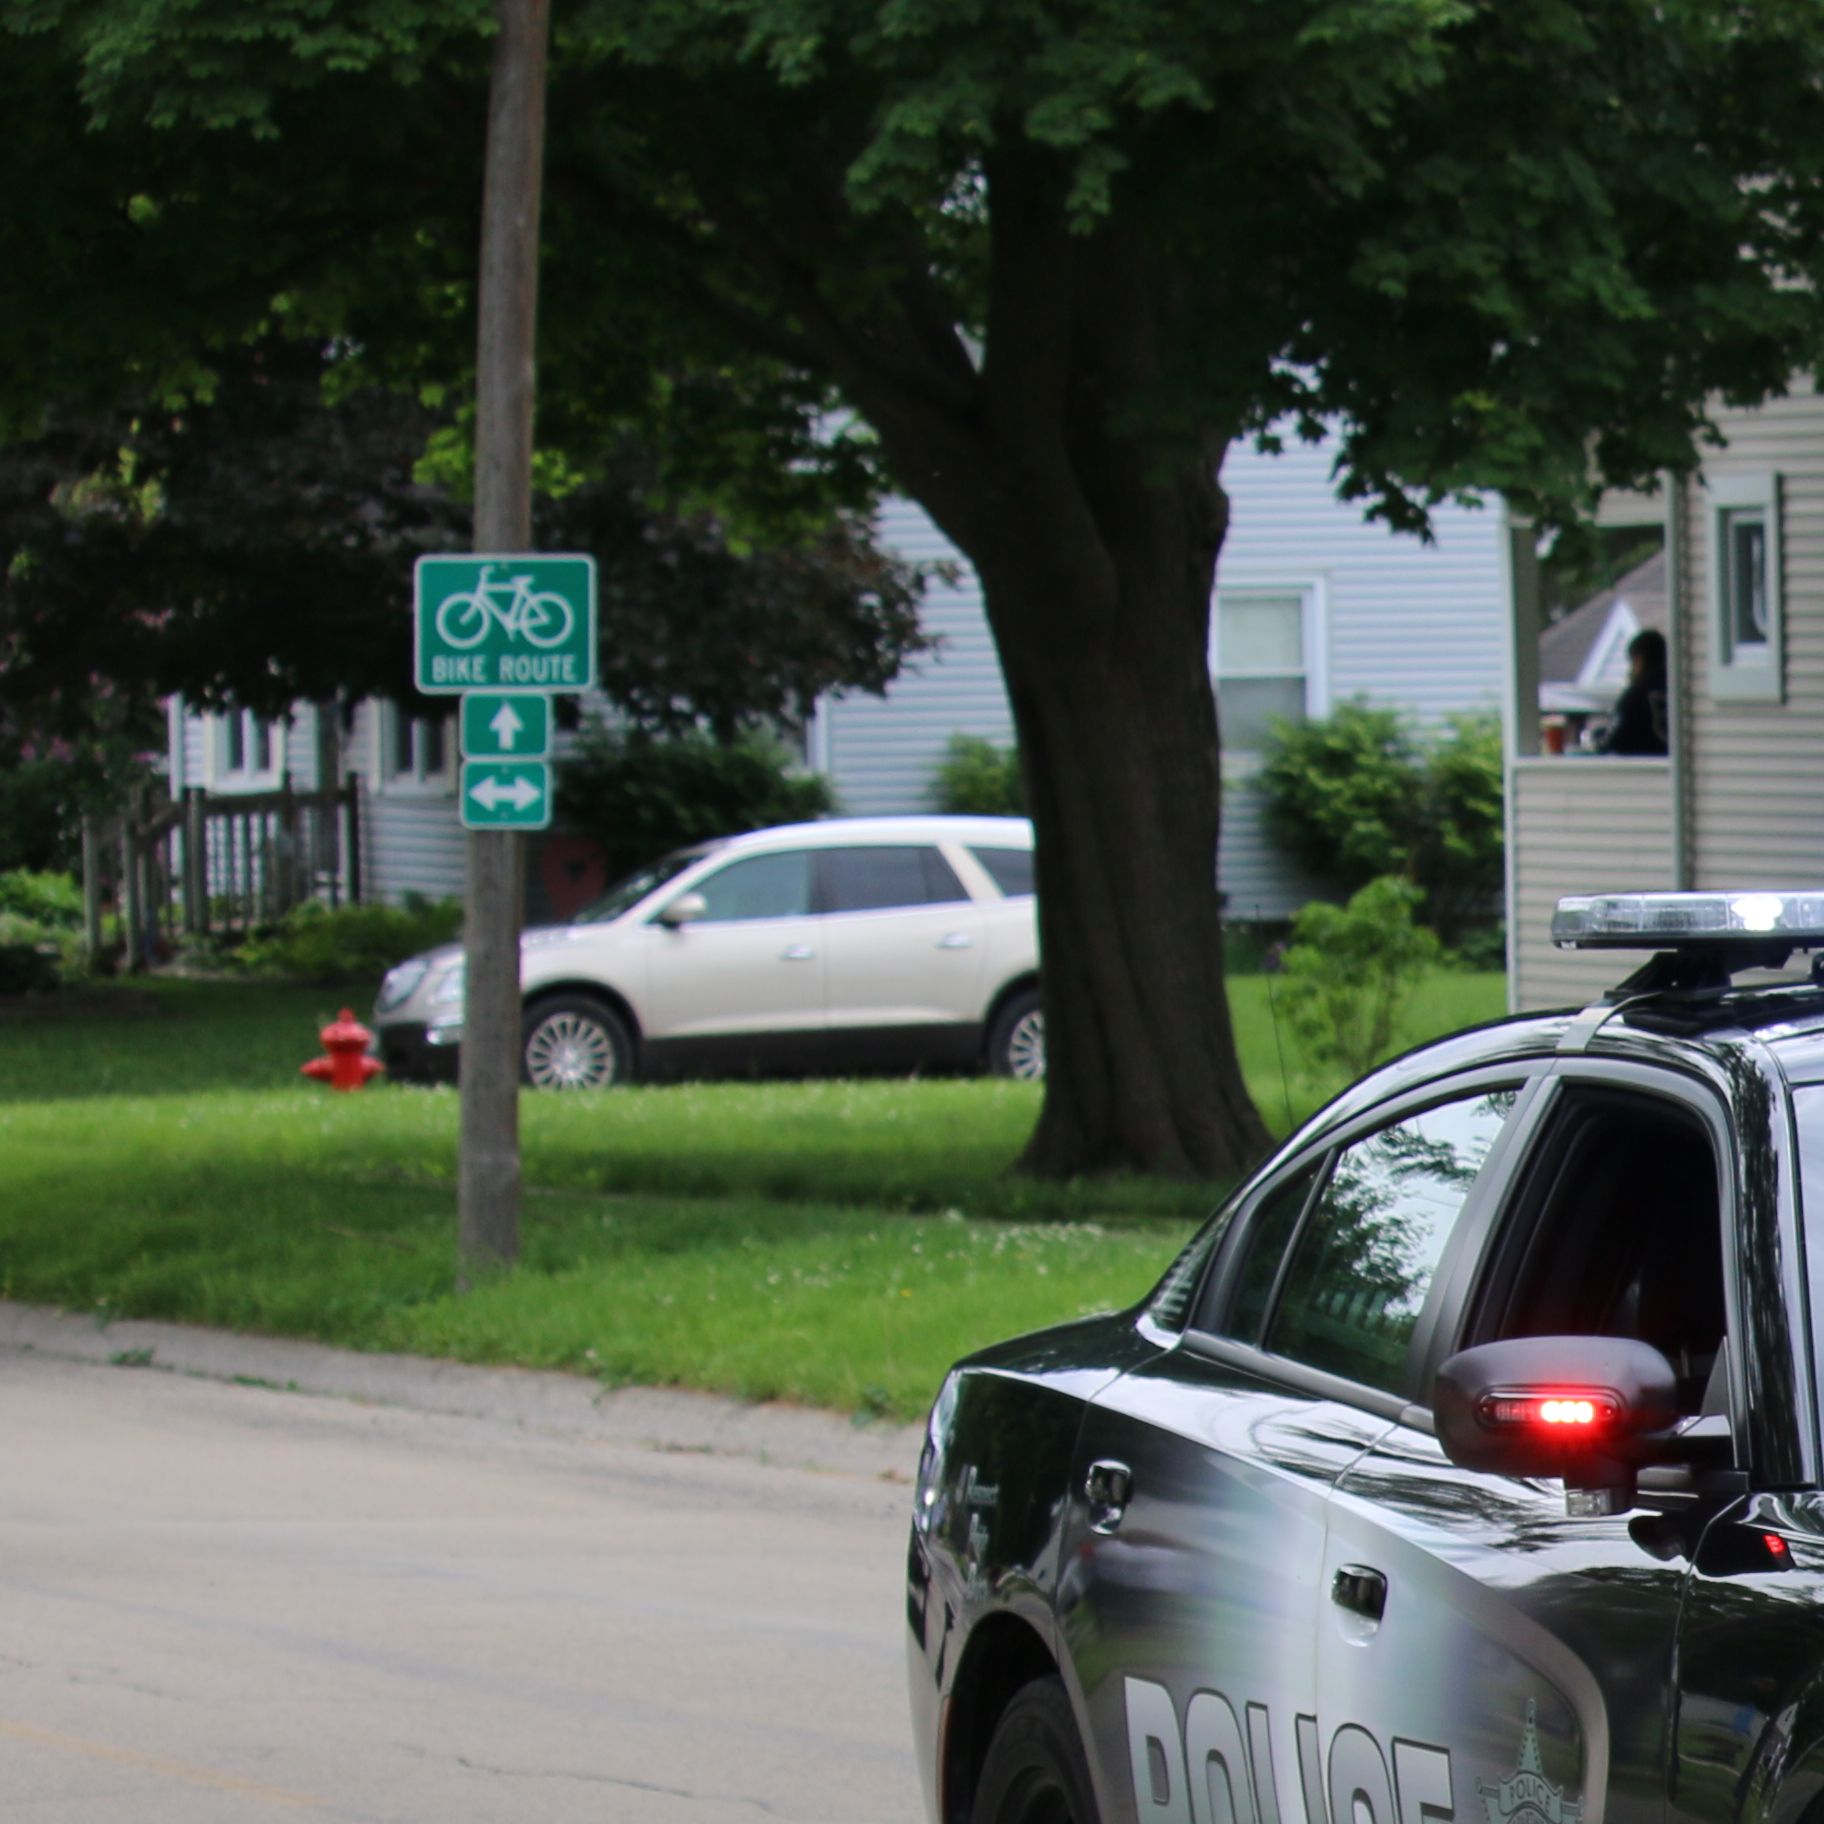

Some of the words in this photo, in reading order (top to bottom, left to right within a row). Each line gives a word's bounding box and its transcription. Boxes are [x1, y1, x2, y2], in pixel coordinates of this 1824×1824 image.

[432, 655, 486, 682] BIKE
[500, 655, 575, 682] ROUTE
[1510, 1778, 1550, 1812] POLICE
